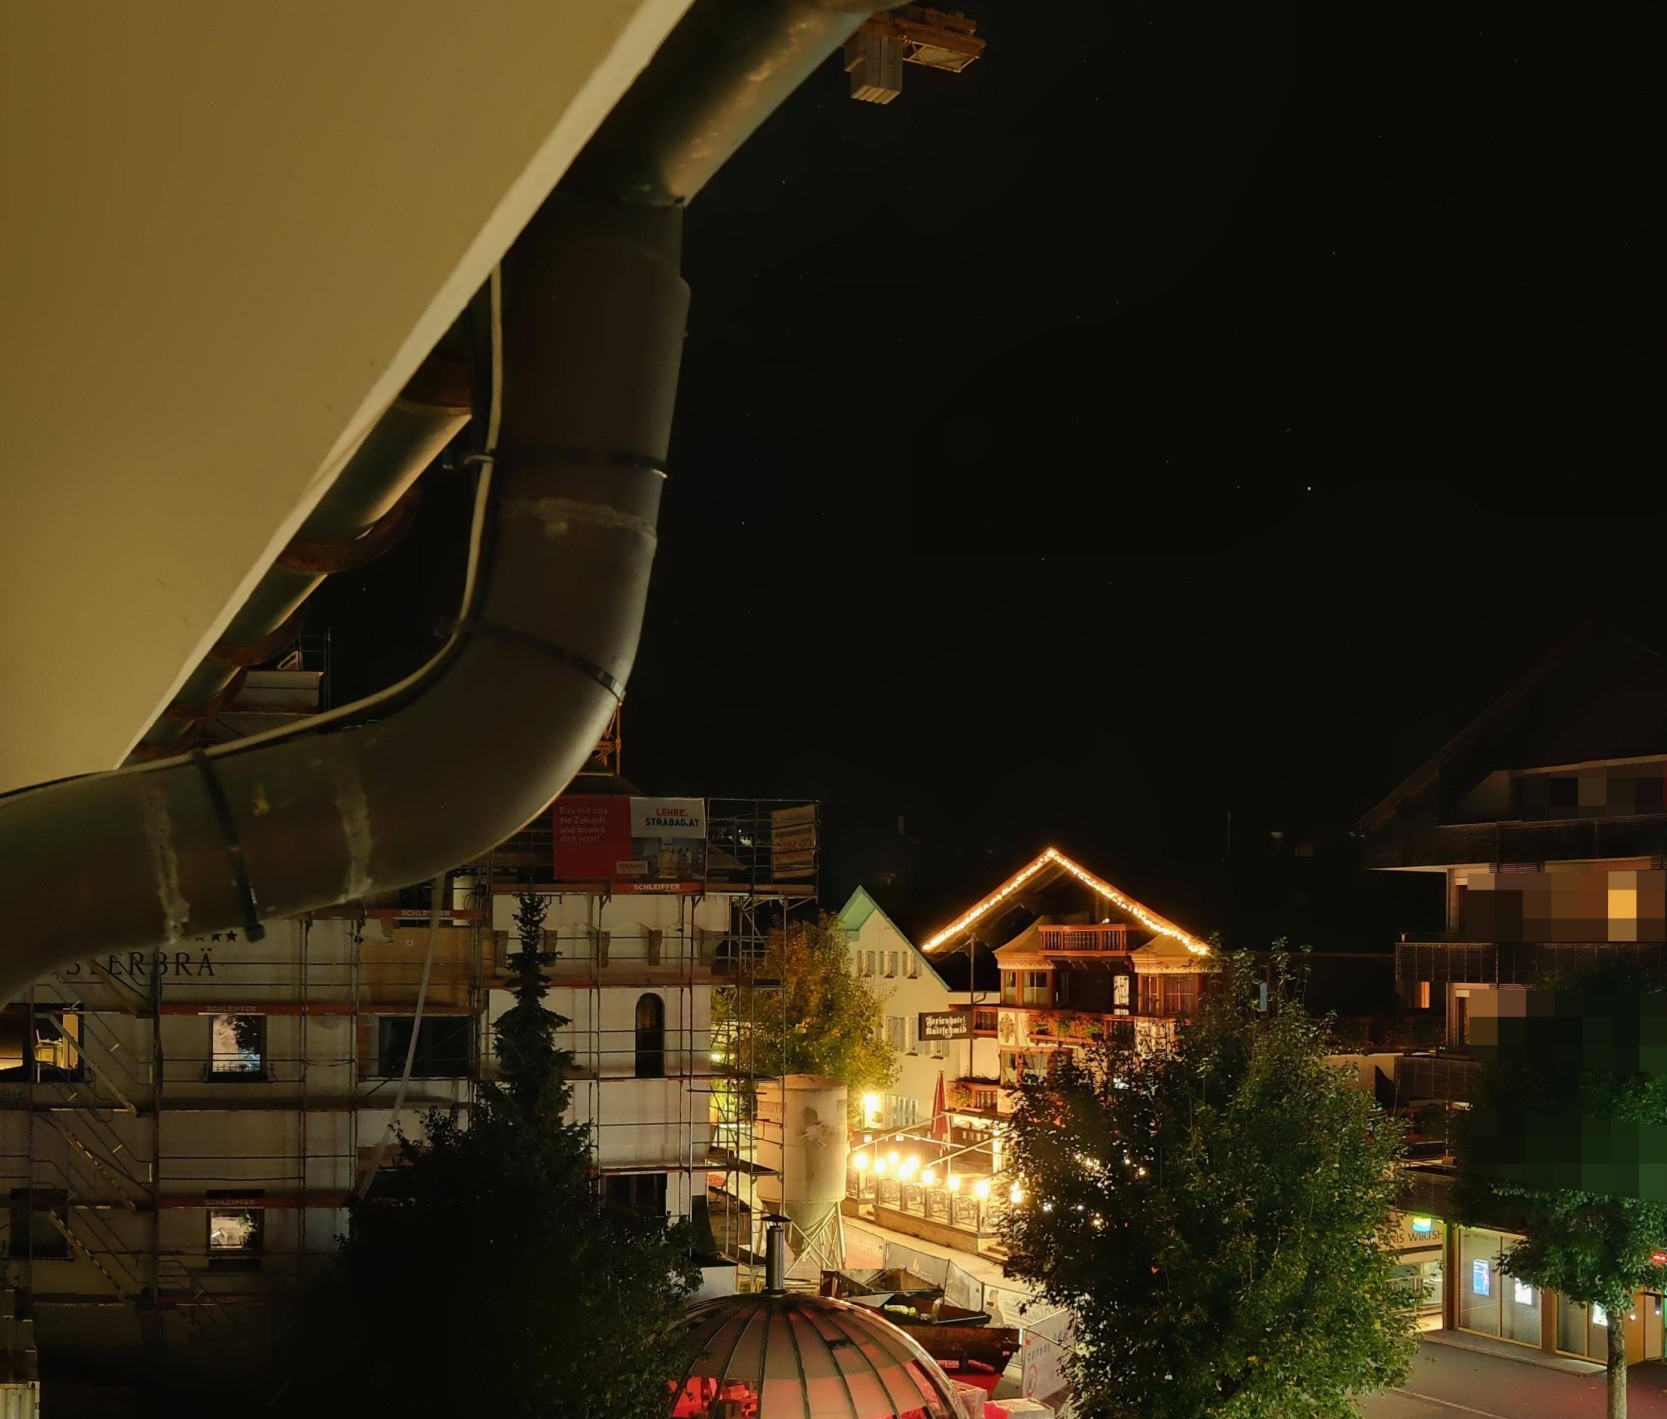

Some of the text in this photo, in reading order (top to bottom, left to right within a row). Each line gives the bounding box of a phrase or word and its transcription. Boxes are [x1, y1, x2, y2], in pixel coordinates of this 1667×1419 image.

[656, 808, 689, 818] LEHRE.
[574, 815, 606, 825] Zukunft
[645, 817, 699, 828] STRABAG.AT
[401, 909, 451, 917] SCHLEFER
